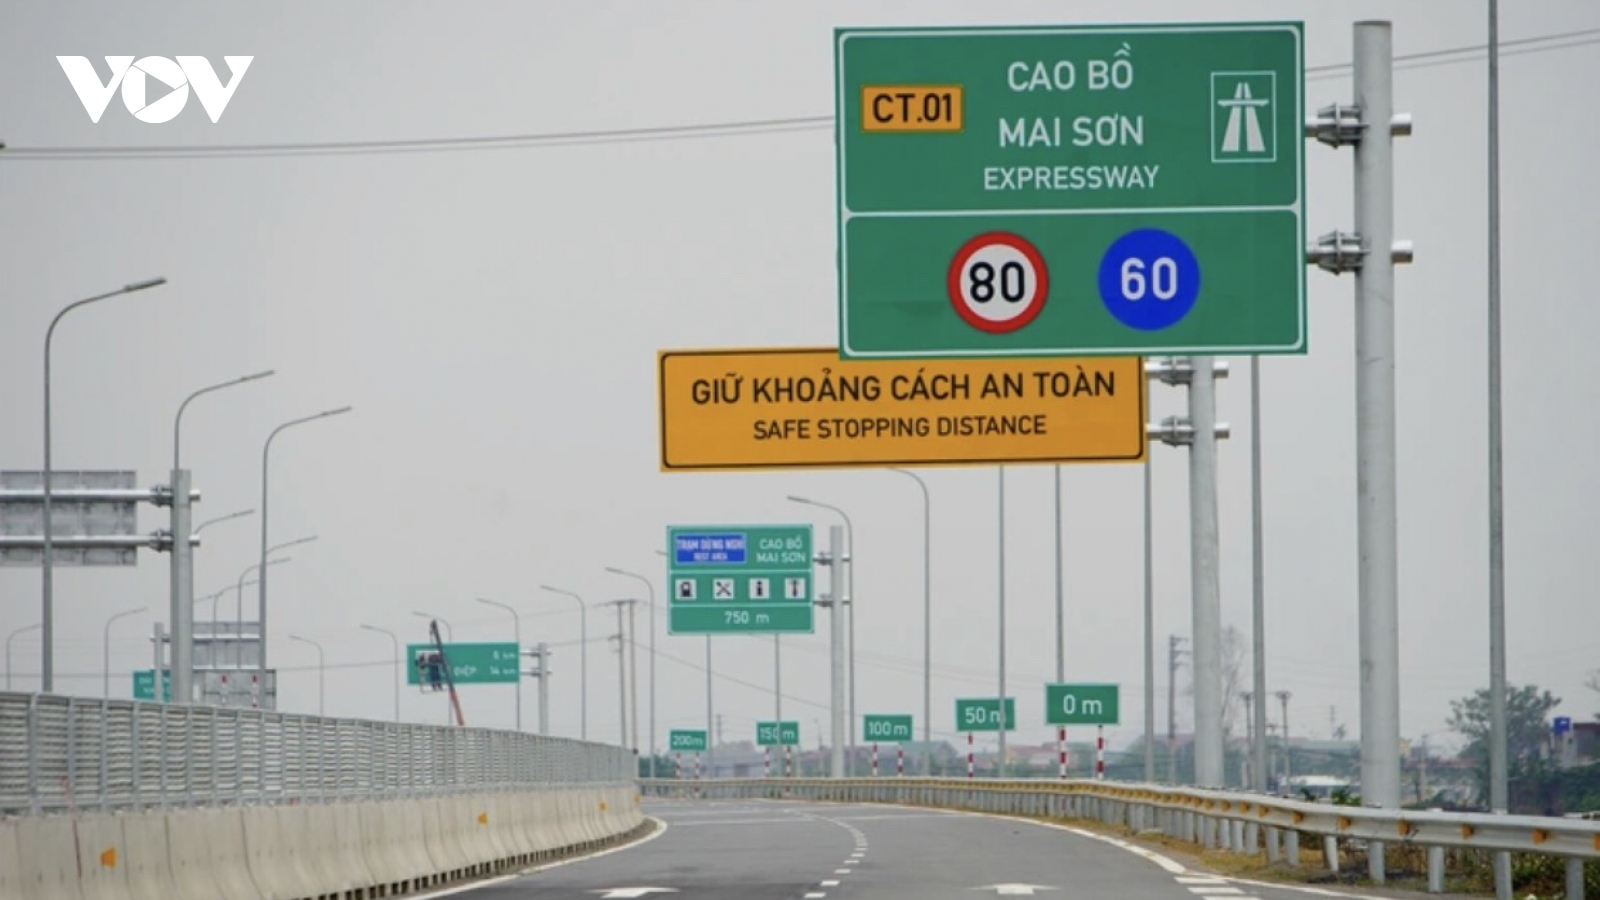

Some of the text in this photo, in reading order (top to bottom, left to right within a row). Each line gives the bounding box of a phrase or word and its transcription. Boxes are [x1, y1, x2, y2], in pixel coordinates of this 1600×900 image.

[1007, 42, 1133, 91] CAO BỒ
[872, 92, 953, 123] CT.01
[1000, 114, 1144, 147] MAI SƠN
[984, 165, 1159, 190] EXPRESSWAY
[969, 260, 1026, 303] 80
[1121, 257, 1178, 301] 60
[691, 367, 1115, 405] GIỮ KHOẢNG CÁCH AN TOÀN
[754, 415, 1046, 440] SAFE STOPPING DISTANCE
[756, 551, 778, 562] MAI
[759, 538, 784, 550] CAO
[724, 611, 769, 624] 750 m
[965, 706, 986, 724] 50
[1062, 695, 1102, 714] 0 m
[782, 730, 795, 740] m
[868, 722, 908, 736] 100 m
